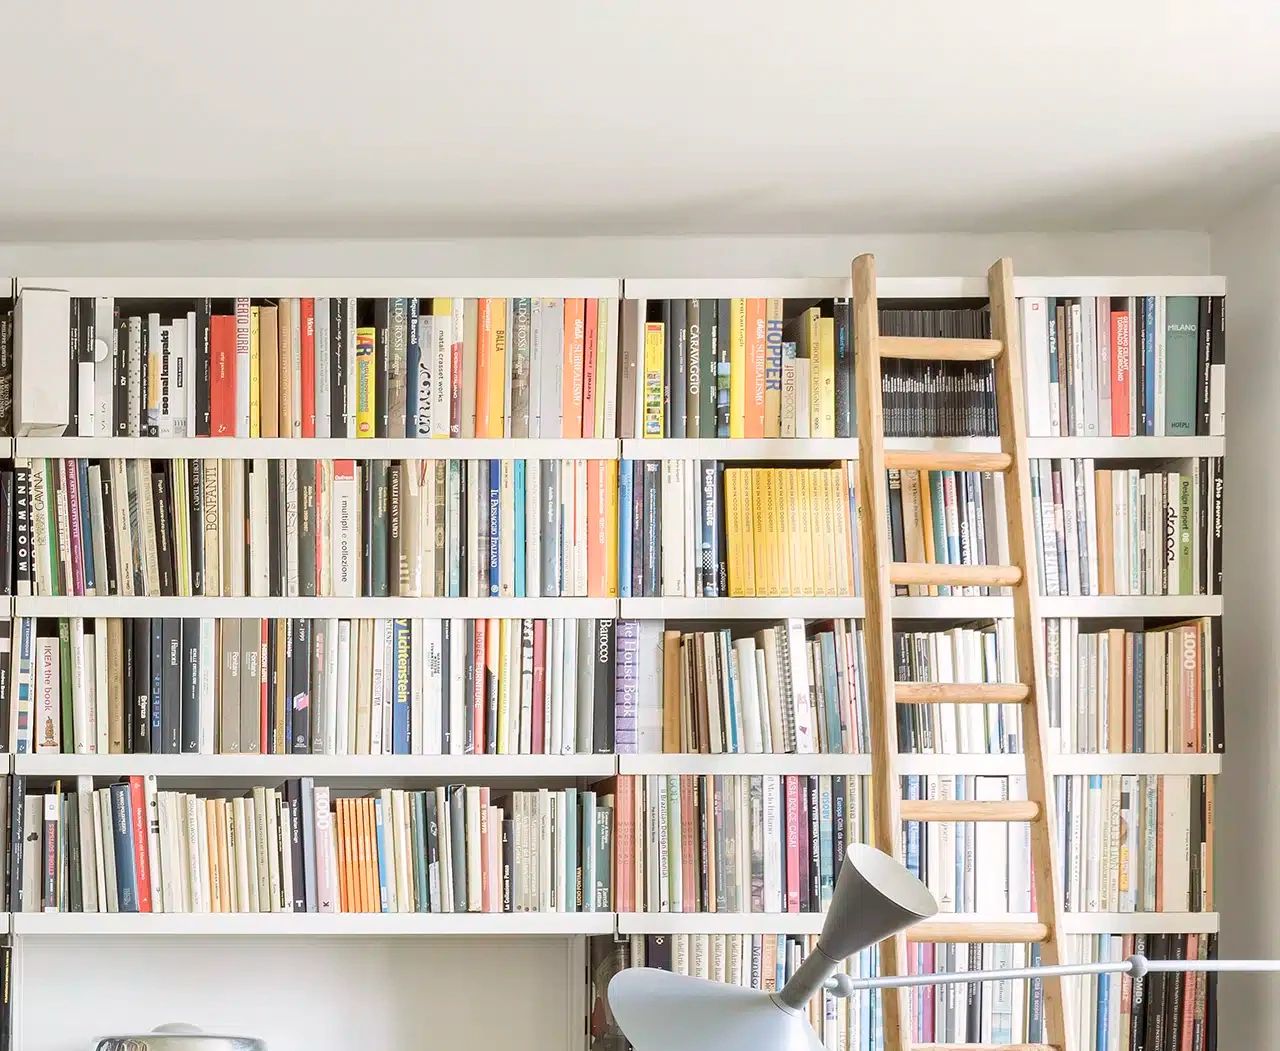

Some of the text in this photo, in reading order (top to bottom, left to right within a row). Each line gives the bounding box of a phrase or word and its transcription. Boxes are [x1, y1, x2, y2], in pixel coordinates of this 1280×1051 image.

[237, 328, 249, 354] BURRI
[394, 298, 403, 351] ALDO ROSSI
[438, 330, 446, 352] matali
[496, 330, 504, 352] BALLA
[518, 298, 527, 351] ALDO ROSSI
[573, 344, 582, 405] SURREALISMO
[689, 325, 699, 395] CARAVAGGIO
[755, 344, 764, 405] SURREALISMO
[766, 319, 782, 391] HOPPER
[438, 383, 446, 402] works
[783, 364, 794, 419] bookshelf
[206, 467, 217, 531] BONFANTI
[704, 469, 714, 526] Design heute
[1181, 481, 1190, 505] Design
[1215, 478, 1223, 498] fabio
[18, 472, 27, 571] MOORMANN
[340, 500, 349, 531] multipli
[1181, 506, 1190, 530] Report
[341, 540, 349, 583] collezione
[599, 619, 612, 663] Barocco
[624, 641, 636, 681] House
[44, 669, 52, 685] the
[398, 630, 410, 703] Lichtenstein
[44, 687, 52, 711] book
[623, 684, 637, 718] Book
